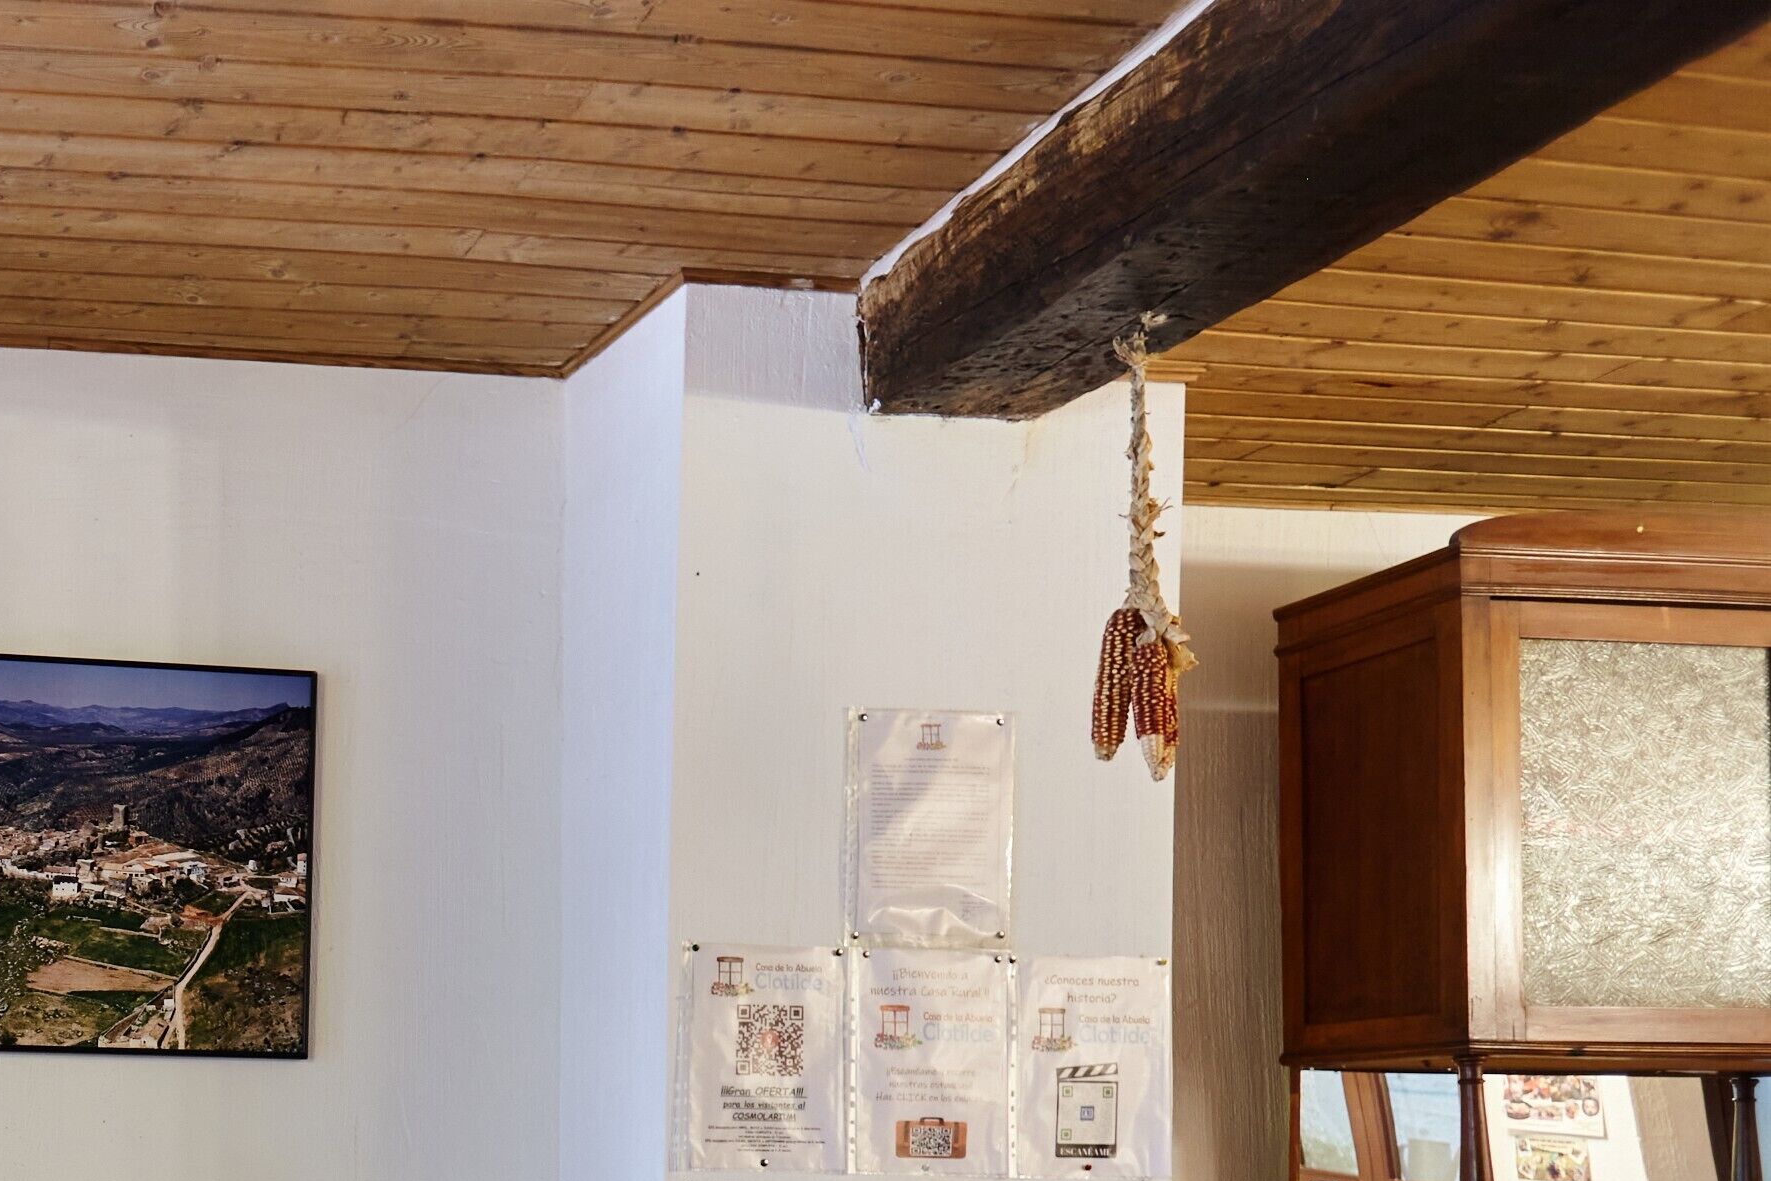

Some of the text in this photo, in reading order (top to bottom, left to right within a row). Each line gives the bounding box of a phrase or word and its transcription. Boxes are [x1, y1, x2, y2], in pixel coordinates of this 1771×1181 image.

[755, 962, 823, 973] Casa de la Abuela
[755, 972, 823, 991] Clotilde
[1044, 974, 1140, 986] ¿Conoces nuestra
[870, 985, 917, 996] nuestra
[920, 985, 947, 997] Casa
[1067, 991, 1118, 1004] historia?
[923, 1011, 942, 1021] Casa
[1078, 1014, 1151, 1024] Casa de la Abuela
[923, 1023, 996, 1042] Clotilde
[1079, 1024, 1150, 1044] Clotilde
[722, 1101, 741, 1109] para
[744, 1100, 755, 1108] los
[797, 1101, 806, 1110] al
[732, 1112, 796, 1121] COSMOLARIUM
